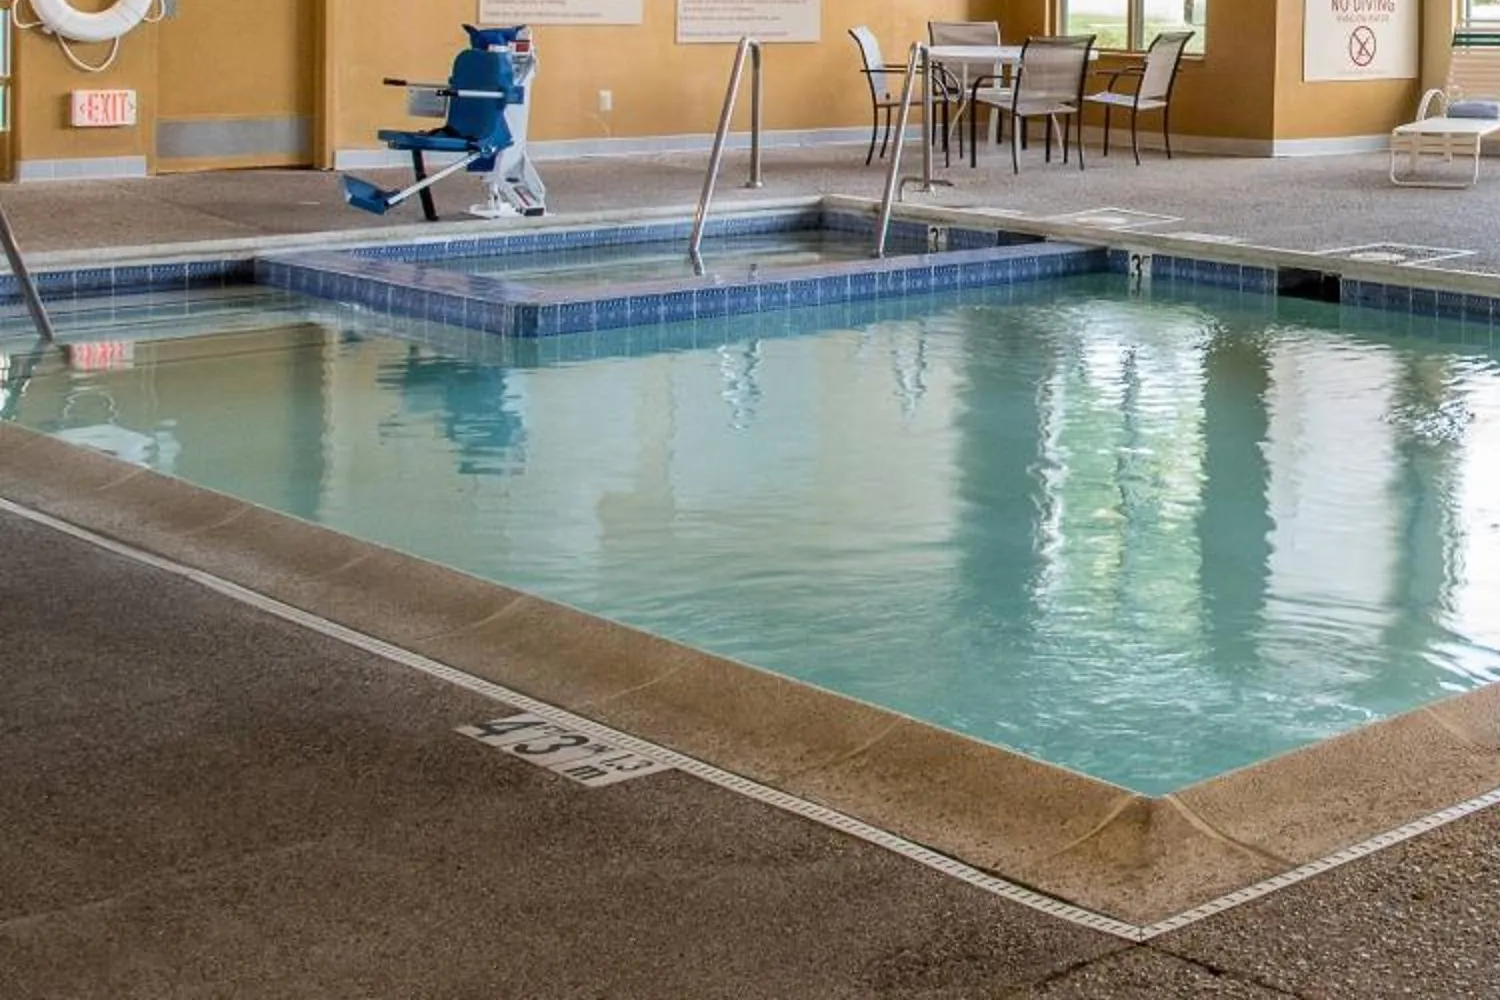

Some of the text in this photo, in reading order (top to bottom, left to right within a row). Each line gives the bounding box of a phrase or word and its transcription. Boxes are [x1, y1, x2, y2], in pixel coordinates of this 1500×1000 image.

[87, 92, 129, 123] EXIT
[473, 720, 546, 738] 4
[513, 734, 589, 755] 3
